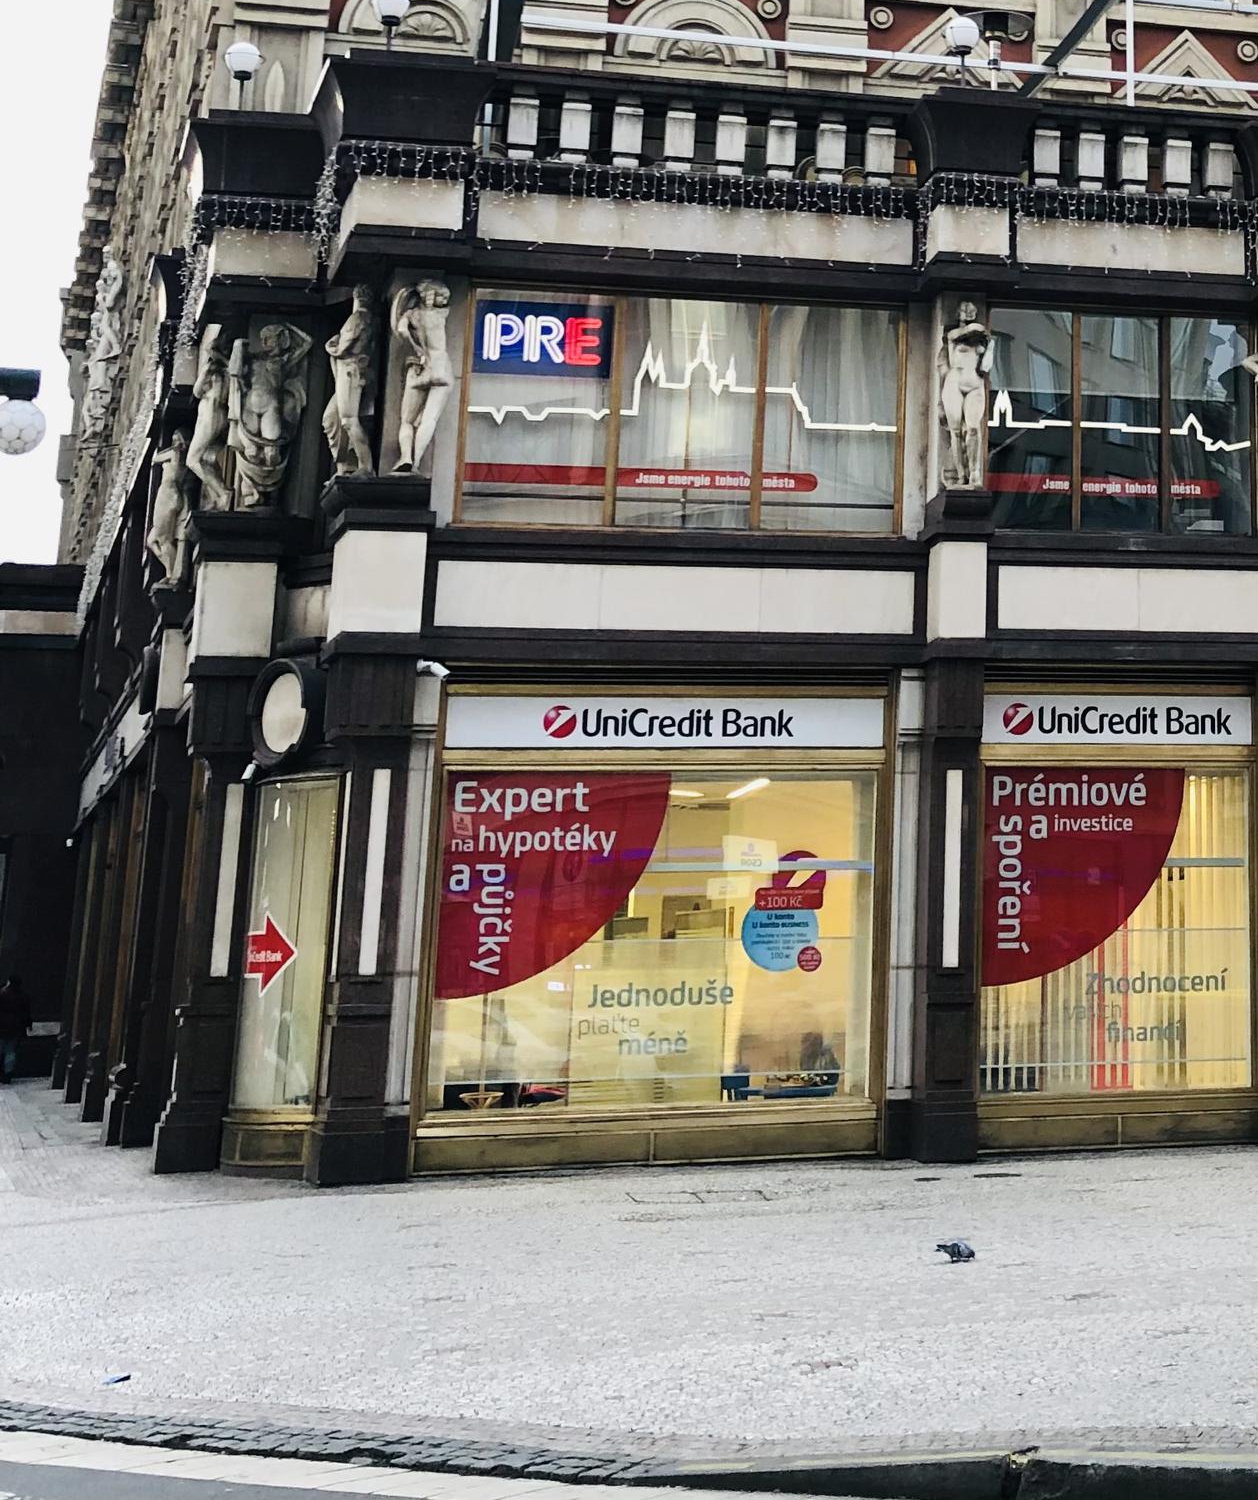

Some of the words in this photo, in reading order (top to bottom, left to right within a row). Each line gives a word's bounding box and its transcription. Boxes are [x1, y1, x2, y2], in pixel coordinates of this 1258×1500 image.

[483, 312, 602, 366] PRE
[1042, 478, 1070, 490] Jsme
[1082, 482, 1121, 495] energie
[1125, 483, 1157, 494] tohoto
[1171, 482, 1201, 494] města
[582, 707, 713, 738] UniCredit
[722, 708, 794, 738] Bank
[1038, 706, 1158, 735] UniCredit
[1166, 707, 1232, 736] Bank
[454, 781, 590, 821] Expert
[992, 773, 1147, 806] Prémiové
[451, 839, 473, 852] na
[478, 823, 616, 858] hypotéky
[1029, 814, 1048, 839] a
[1054, 814, 1133, 832] investice
[450, 863, 470, 891] a
[992, 814, 1031, 954] spoření
[469, 864, 514, 976] půjčky
[588, 979, 734, 1008] Jednoduše
[1085, 968, 1228, 995] Zhodnocení
[1063, 1001, 1122, 1020] vach
[578, 1013, 640, 1040] plaťte
[619, 1030, 688, 1055] méně
